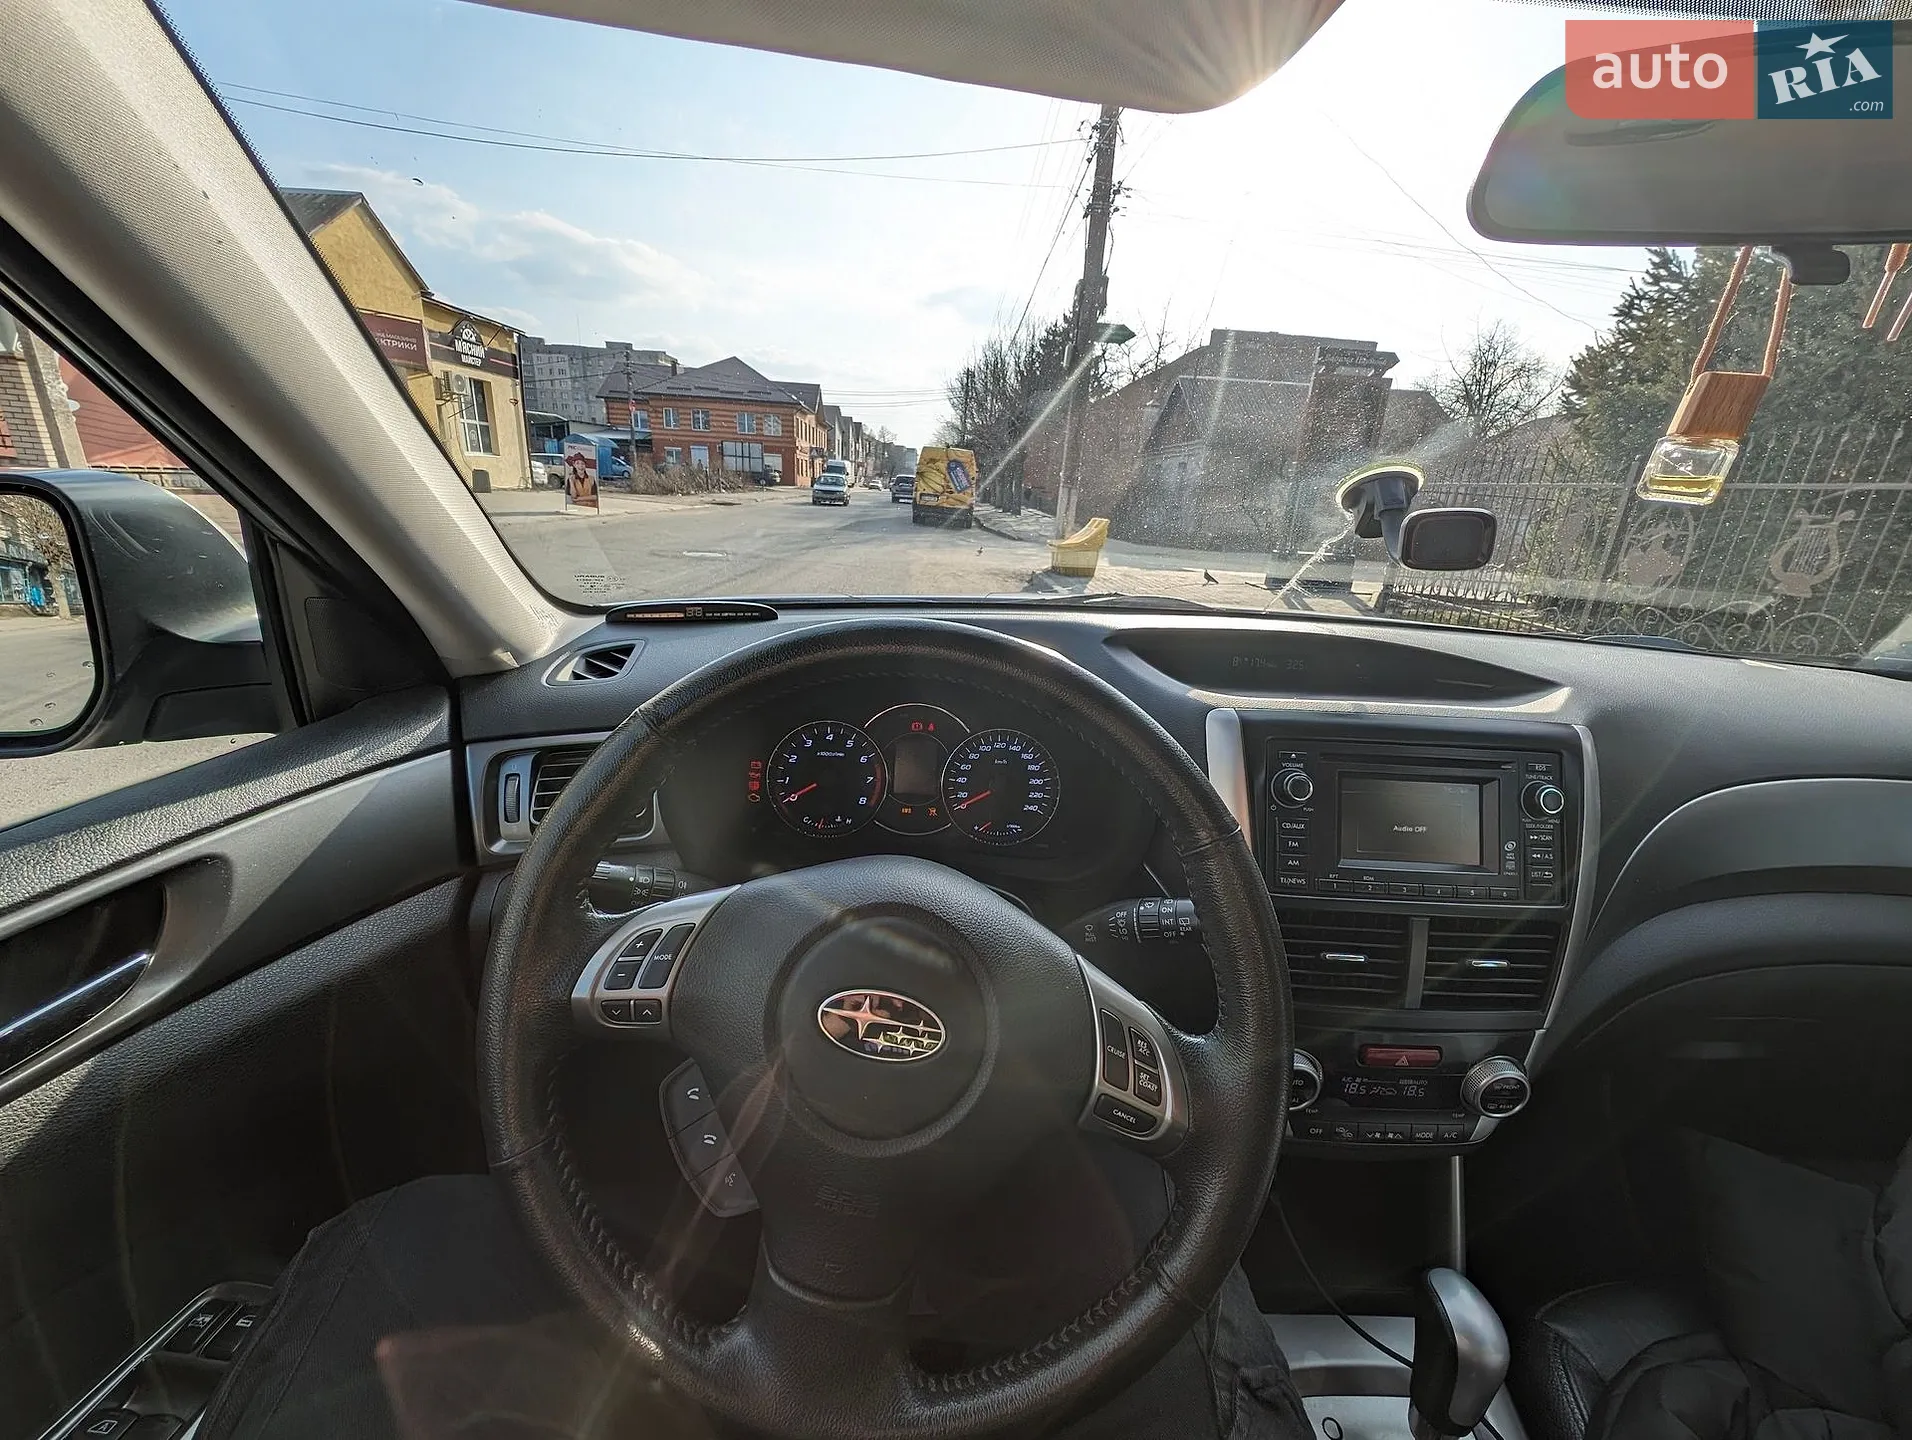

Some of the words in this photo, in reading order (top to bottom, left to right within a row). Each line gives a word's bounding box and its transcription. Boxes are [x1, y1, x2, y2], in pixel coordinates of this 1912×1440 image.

[804, 739, 813, 747] 3
[846, 740, 855, 748] 5
[788, 755, 798, 763] 2
[860, 755, 868, 763] 6
[866, 776, 874, 784] 7
[858, 797, 867, 805] 8
[1281, 822, 1306, 830] CD/AUX
[653, 953, 673, 961] MODE
[1106, 1045, 1127, 1060] CRUISE
[1139, 1072, 1150, 1081] SET
[1139, 1080, 1159, 1092] COAST
[1112, 1109, 1137, 1124] CANCEL
